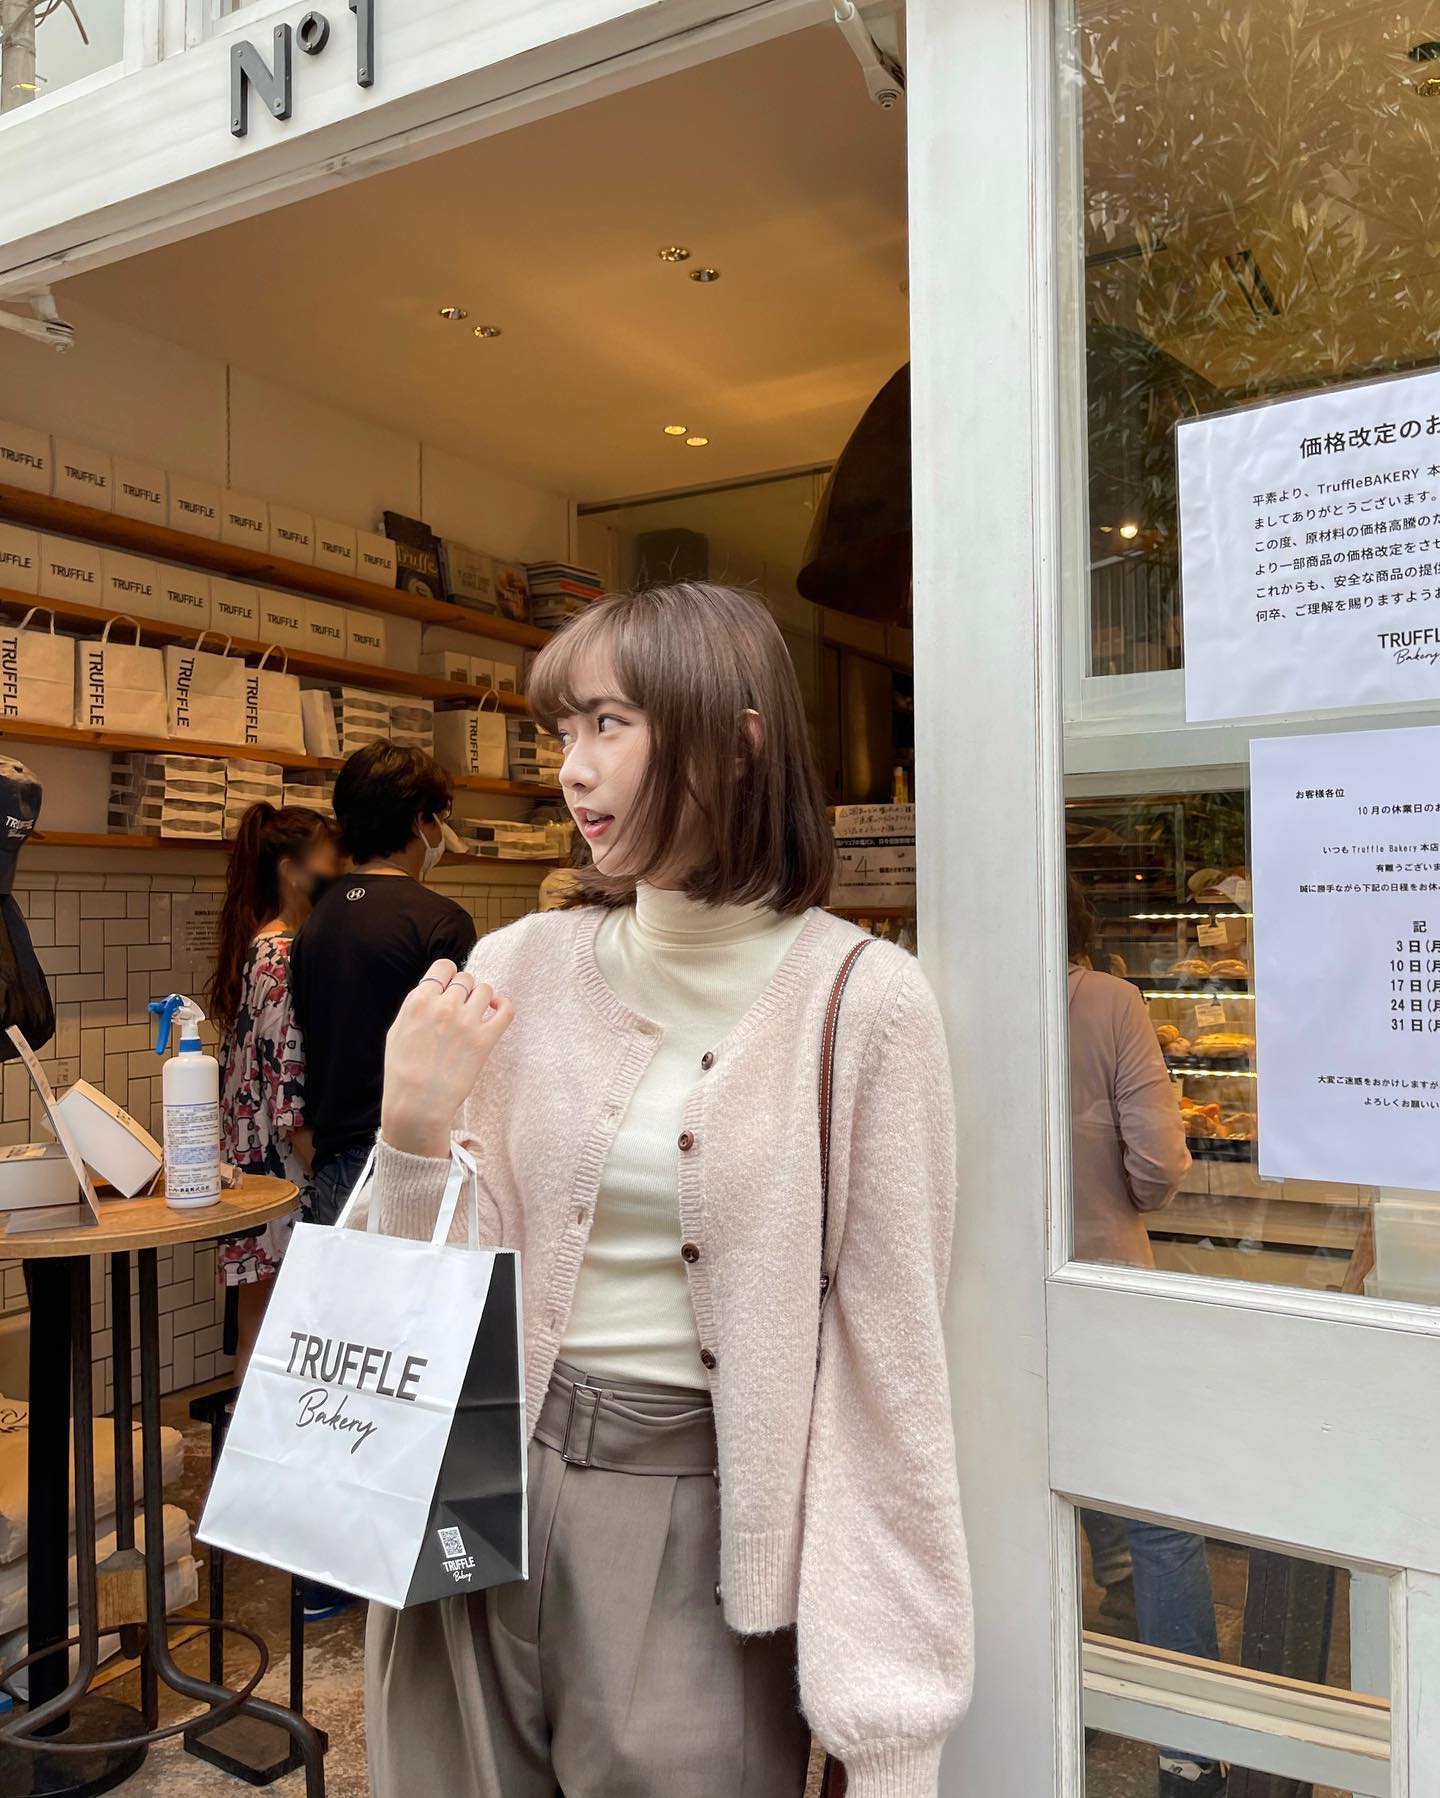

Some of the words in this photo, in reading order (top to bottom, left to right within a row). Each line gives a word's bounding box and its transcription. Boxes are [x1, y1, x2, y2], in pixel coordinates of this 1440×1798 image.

[1299, 414, 1440, 459] 価格改定のお
[0, 448, 43, 469] TRUFFLE
[64, 466, 105, 487] TRUFFLE
[123, 484, 160, 503] TRUFFLE
[179, 500, 214, 518] TRUFFLE
[1254, 490, 1437, 530] ましてありがとうございます。
[229, 515, 262, 531] TRUFFLE
[278, 529, 308, 545] TRUFFLE
[322, 542, 350, 558] TRUFFLE
[364, 554, 391, 569] TRUFFLE
[51, 564, 94, 582] TRUFFLE
[112, 578, 152, 595] TRUFFLE
[168, 591, 203, 607] TRUFFLE
[219, 603, 252, 618] TRUFFLE
[267, 613, 298, 628] TRUFFLE
[311, 624, 340, 638] TRUFFLE
[353, 634, 379, 647] TRUFFLE
[1393, 647, 1440, 666] Bakery
[2, 637, 18, 716] TRUFFLE
[89, 651, 104, 725] TRUFFLE
[177, 658, 195, 727] TRUFFLE
[246, 677, 258, 744] TRUFFLE
[469, 717, 480, 774] TRUFFLE
[1295, 788, 1345, 800] お客様各位
[1389, 844, 1418, 853] Bakery
[1299, 882, 1440, 894] 誠に勝手ながら下記の日程をお休
[1413, 921, 1427, 933] 記
[1317, 1075, 1440, 1090] 大変ご迷惑をおかけしますが
[286, 1331, 428, 1402] TRUFFLE
[296, 1387, 378, 1455] Bakery
[442, 1556, 476, 1573] TRUFFLE
